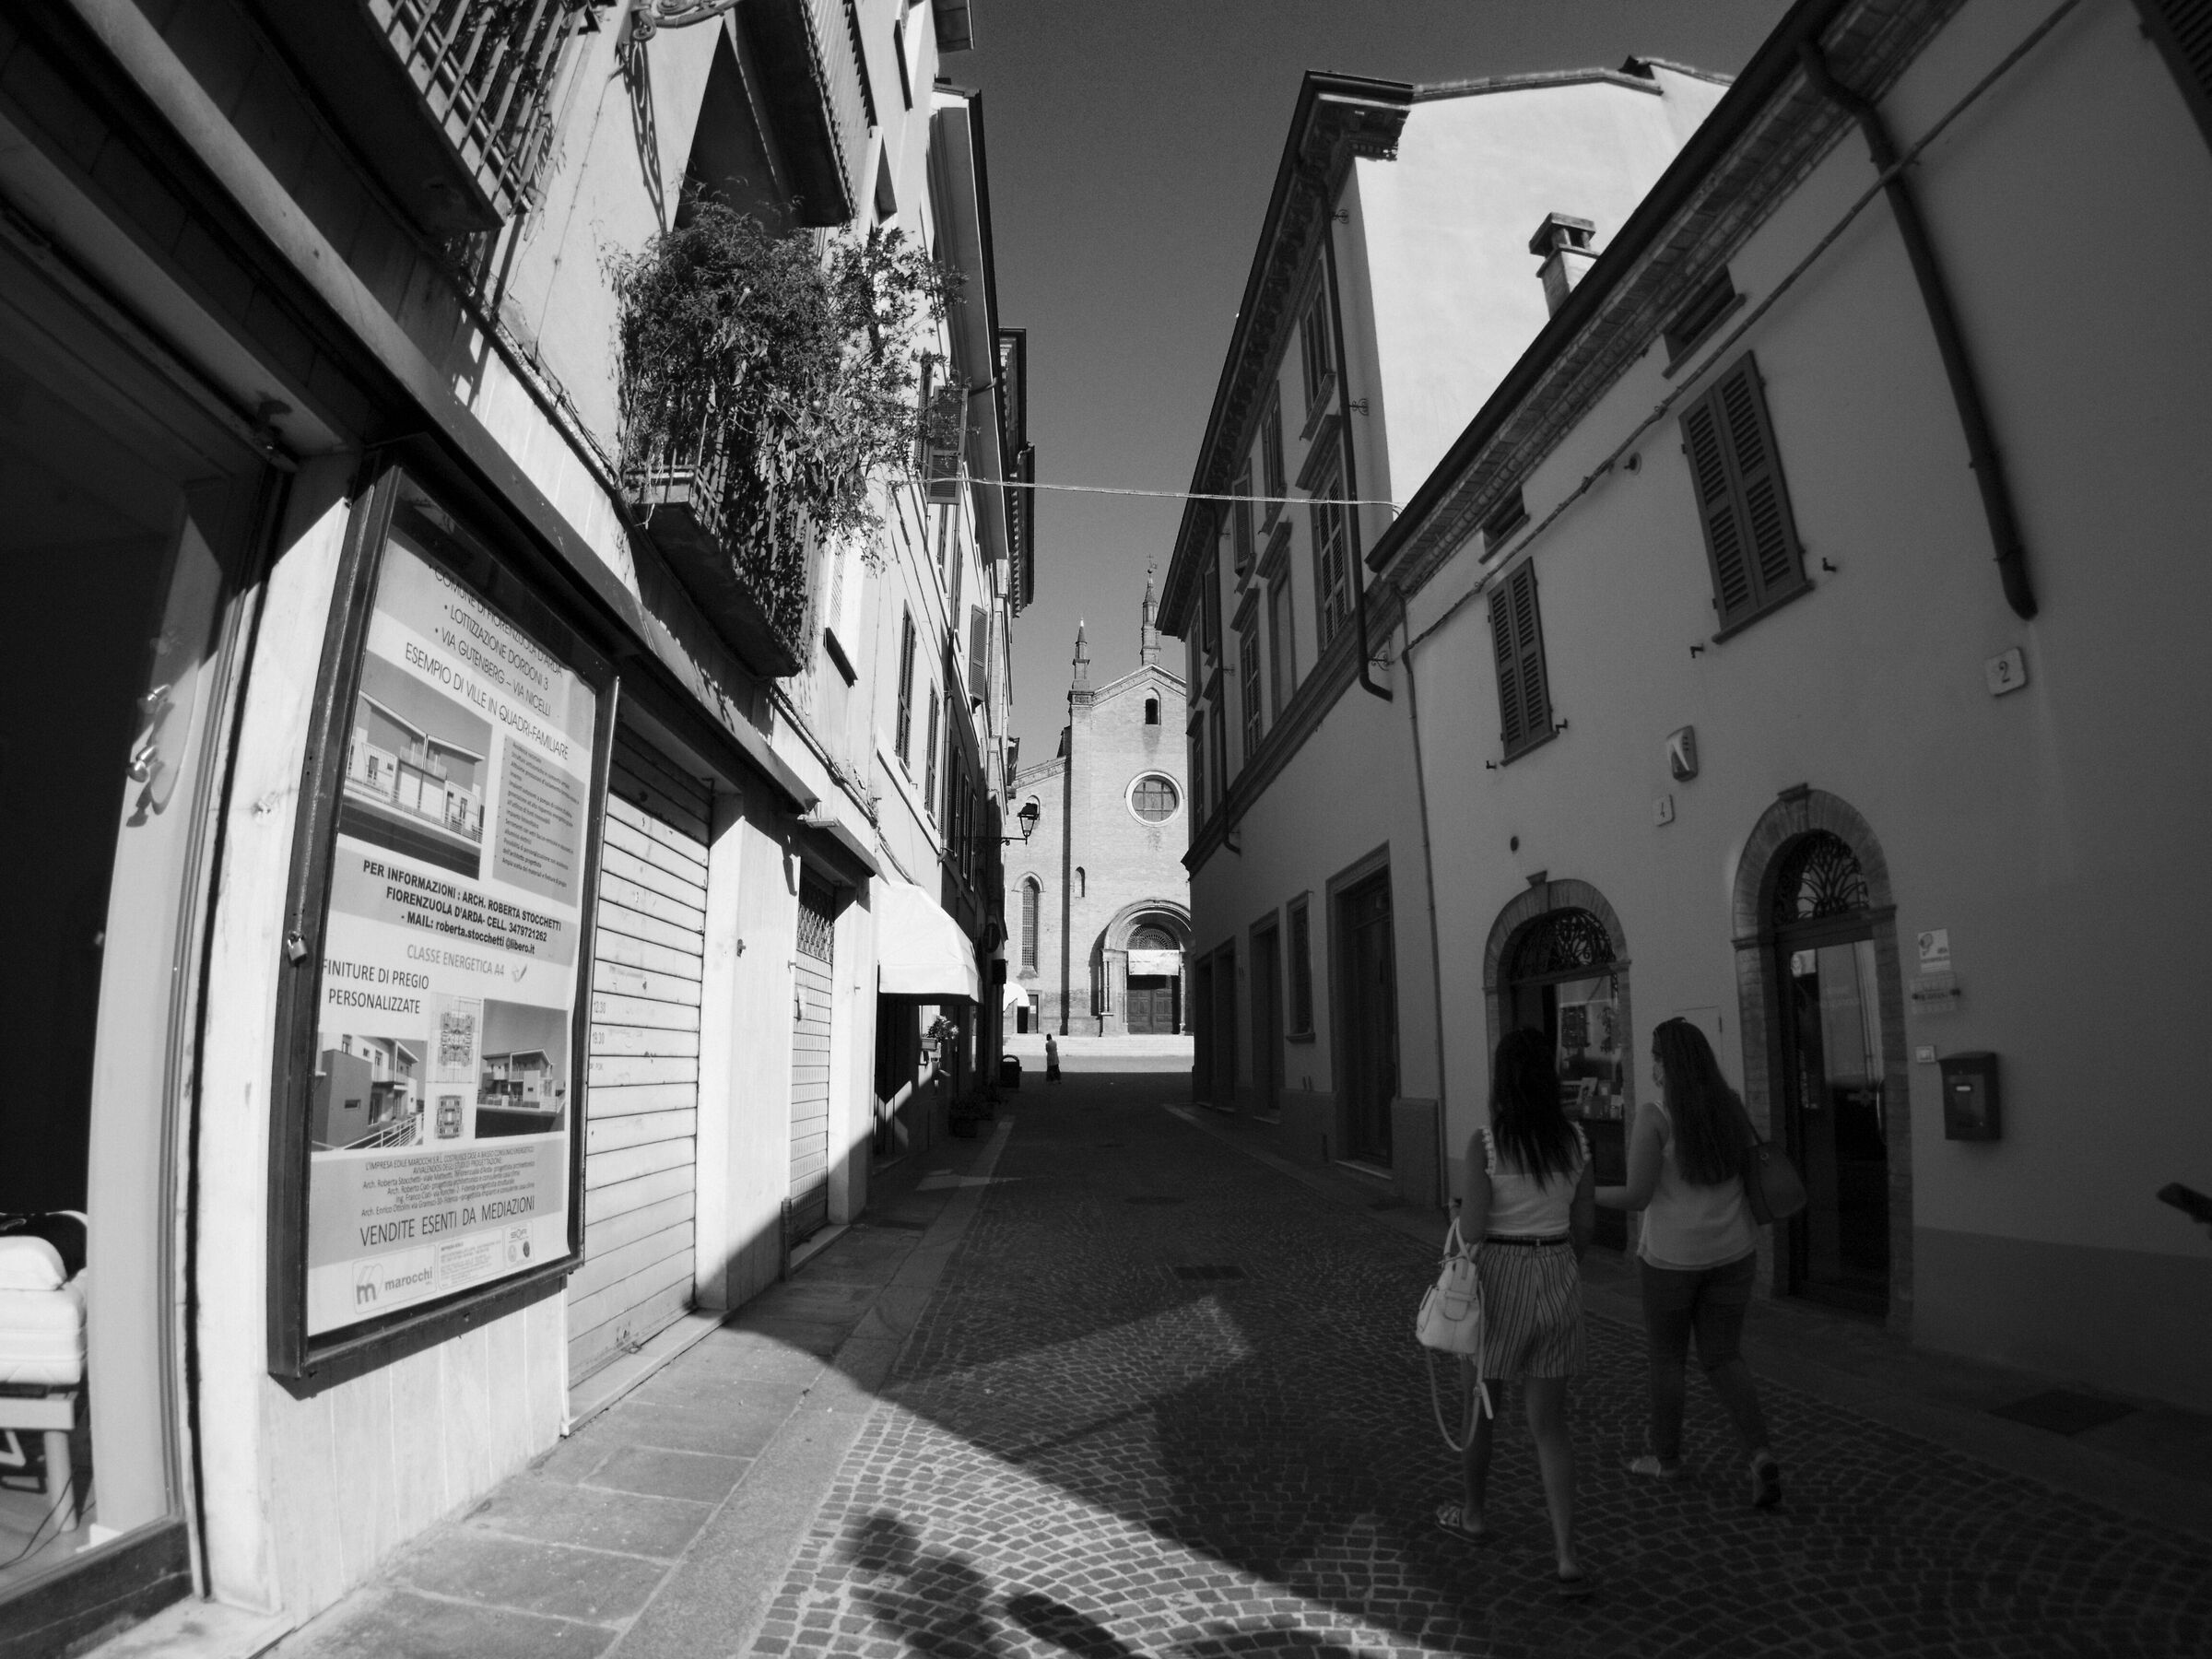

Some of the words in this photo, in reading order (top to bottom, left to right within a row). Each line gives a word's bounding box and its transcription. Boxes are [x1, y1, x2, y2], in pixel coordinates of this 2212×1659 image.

[435, 567, 476, 607] COMUNE
[450, 604, 506, 659] LOTTIZZAZIONE
[508, 649, 542, 687] DORDONI
[544, 677, 549, 691] 3
[441, 627, 456, 649] VIA
[458, 640, 505, 684] GUTENBERG
[512, 678, 524, 697] VIA
[526, 689, 551, 717] NICELLI
[1998, 660, 2010, 684] 2
[406, 641, 451, 685] ESEMPIO
[453, 673, 464, 692] DI
[466, 681, 487, 709] VILLE
[488, 698, 498, 716] IN
[499, 704, 569, 760] QUADRI-FAMILIARE
[363, 859, 384, 877] PER
[387, 866, 456, 899] INFORMAZIONI
[462, 890, 486, 908] ARCH.
[488, 899, 521, 920] ROBERTA
[522, 910, 562, 931] STOCCHETTI
[386, 886, 453, 916] FIORENZUOLA
[487, 914, 507, 931] CELL.
[509, 922, 547, 942] 3479721262
[406, 910, 434, 929] MAIL:
[435, 921, 505, 947] roberta.stocchetti
[323, 958, 375, 982] FINITURE
[378, 967, 389, 984] DI
[392, 971, 429, 990] PREGIO
[406, 943, 441, 963] CLASSE
[442, 951, 493, 974] ENERGETICA
[494, 964, 505, 976] A4
[328, 988, 421, 1015] PERSONALIZZATE
[359, 1220, 415, 1247] VENDITE
[422, 1212, 457, 1237] ESENTI
[463, 1208, 477, 1227] DA
[481, 1195, 535, 1222] MEDIAZIONI
[384, 1265, 433, 1291] marocchi
